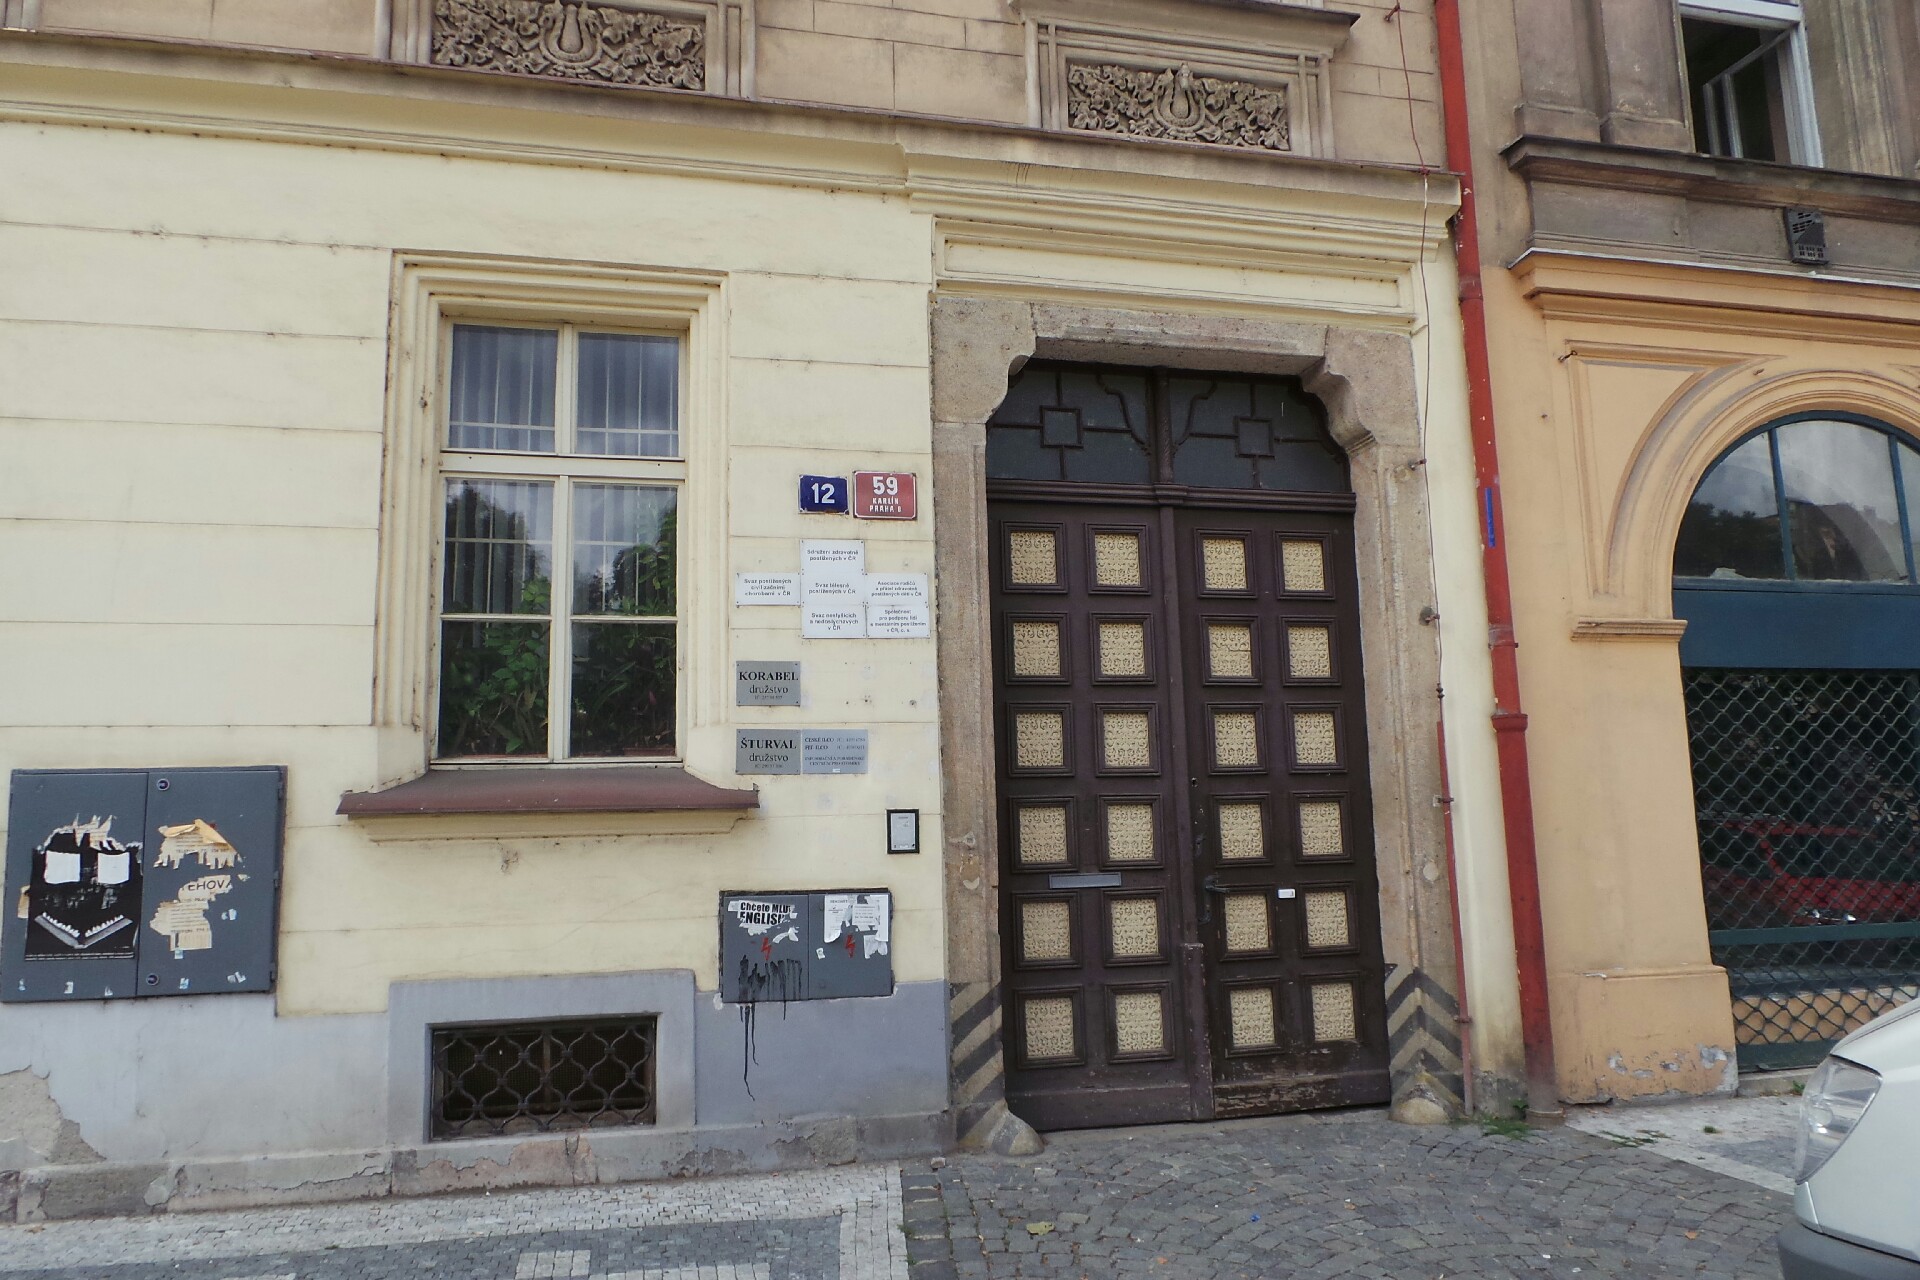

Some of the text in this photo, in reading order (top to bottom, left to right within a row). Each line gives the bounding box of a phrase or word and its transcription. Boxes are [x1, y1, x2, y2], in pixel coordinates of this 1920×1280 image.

[872, 475, 898, 496] 59
[811, 482, 835, 504] 12
[872, 496, 899, 505] KARLÍN
[869, 505, 895, 513] PRAHA
[739, 671, 799, 681] KORABEL
[749, 684, 789, 694] družstvo
[740, 736, 797, 749] ŠTURVAL
[749, 752, 789, 762] družstvo
[740, 902, 770, 912] Chcete
